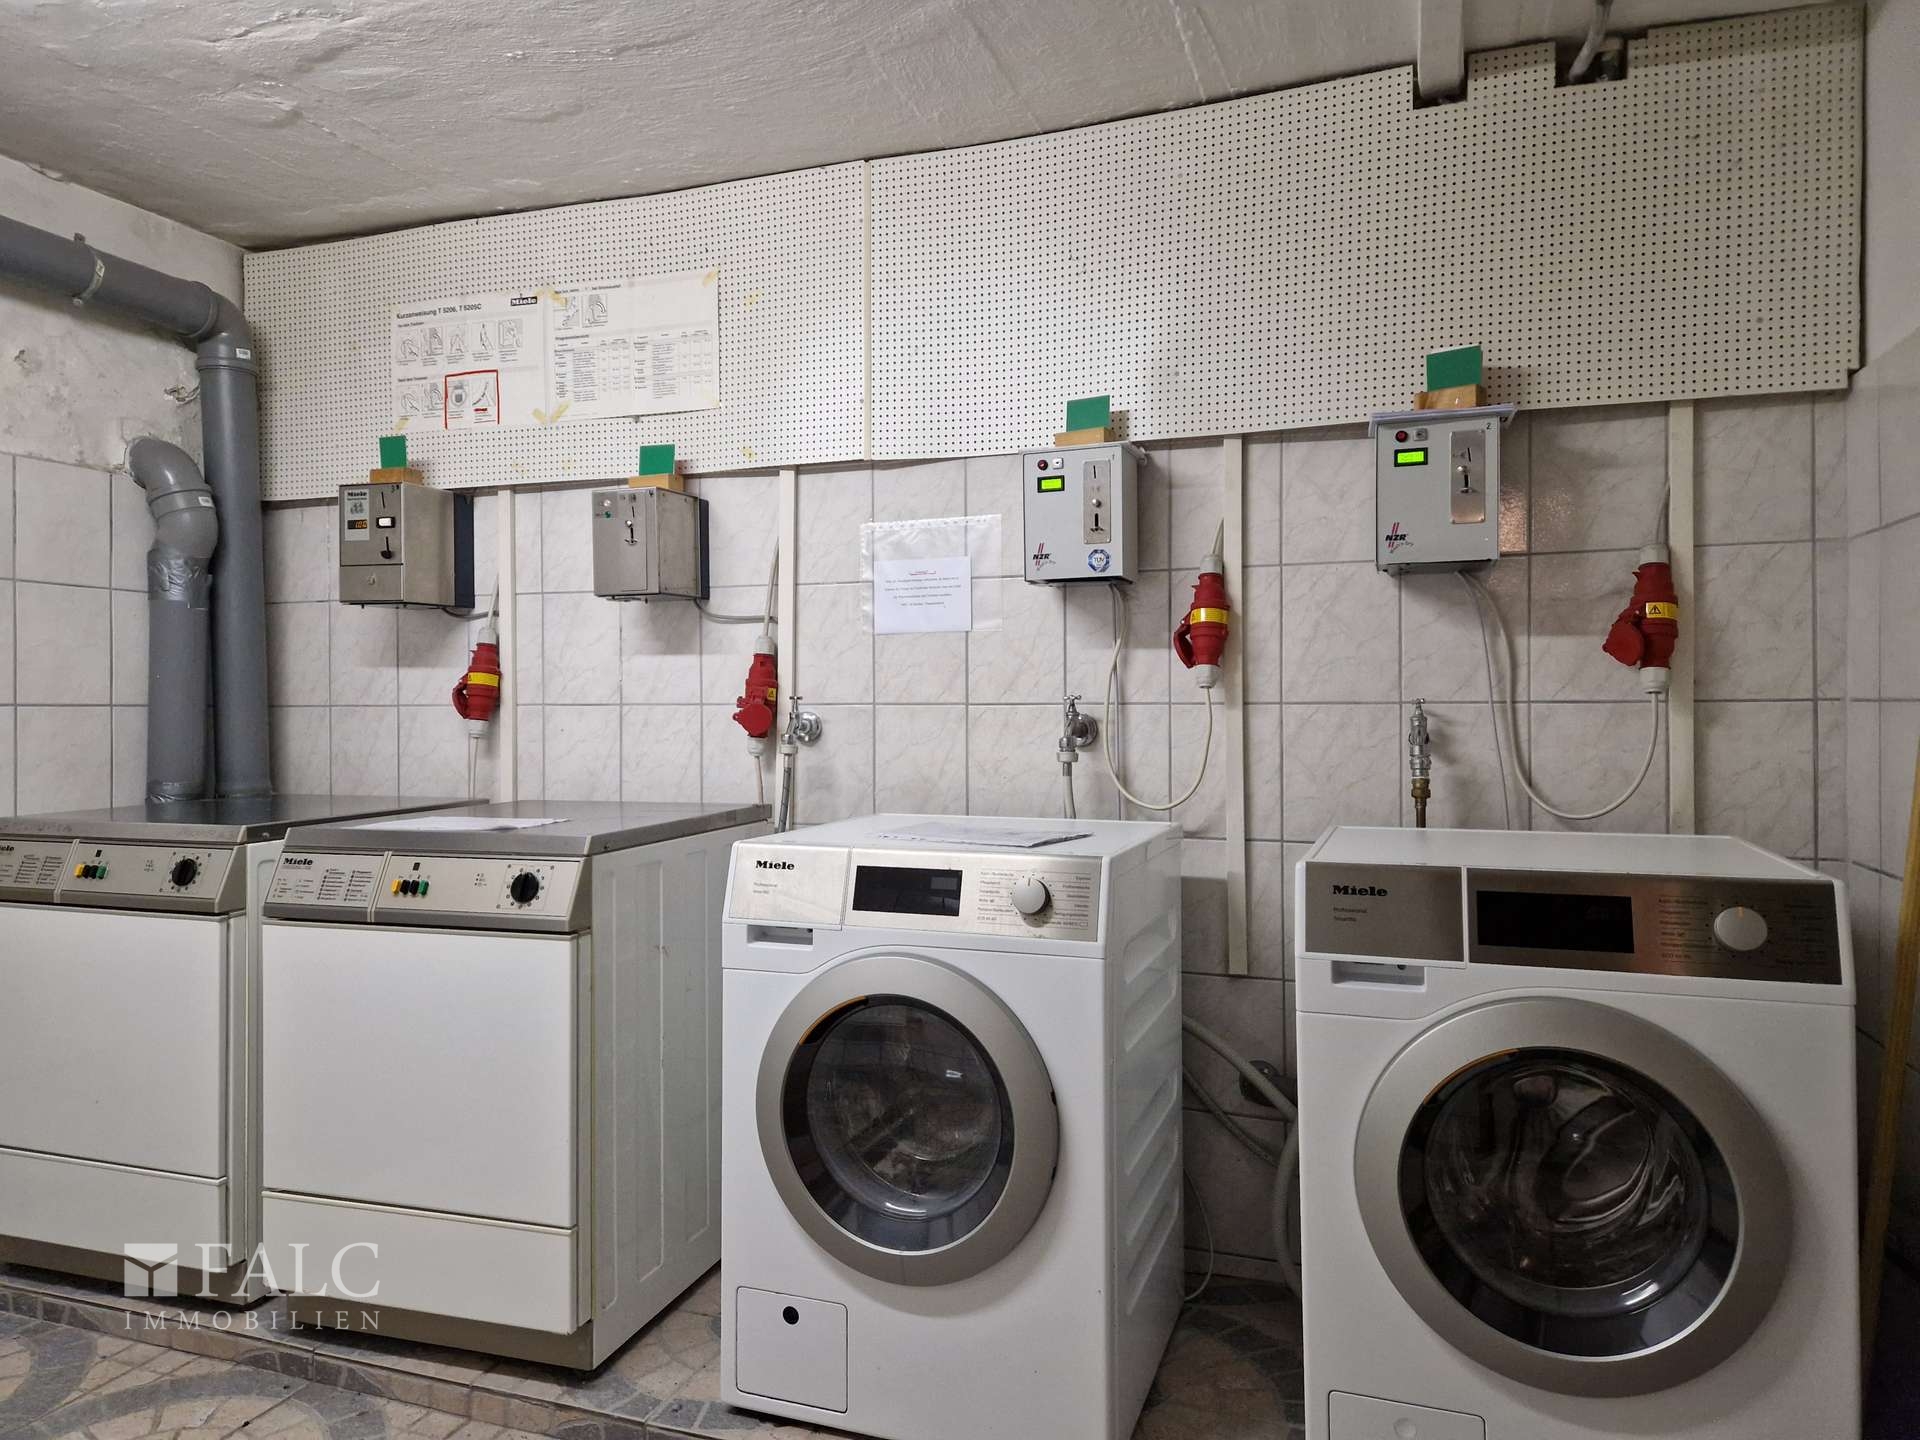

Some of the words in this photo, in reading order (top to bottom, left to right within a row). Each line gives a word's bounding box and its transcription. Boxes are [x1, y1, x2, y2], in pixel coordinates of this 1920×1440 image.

[511, 297, 538, 306] Miele
[396, 308, 437, 320] Kurzanweisung
[1385, 533, 1407, 542] NZR
[1032, 553, 1050, 561] NZR
[283, 857, 314, 866] Miele
[755, 859, 795, 871] Miele
[1332, 884, 1388, 897] Miele
